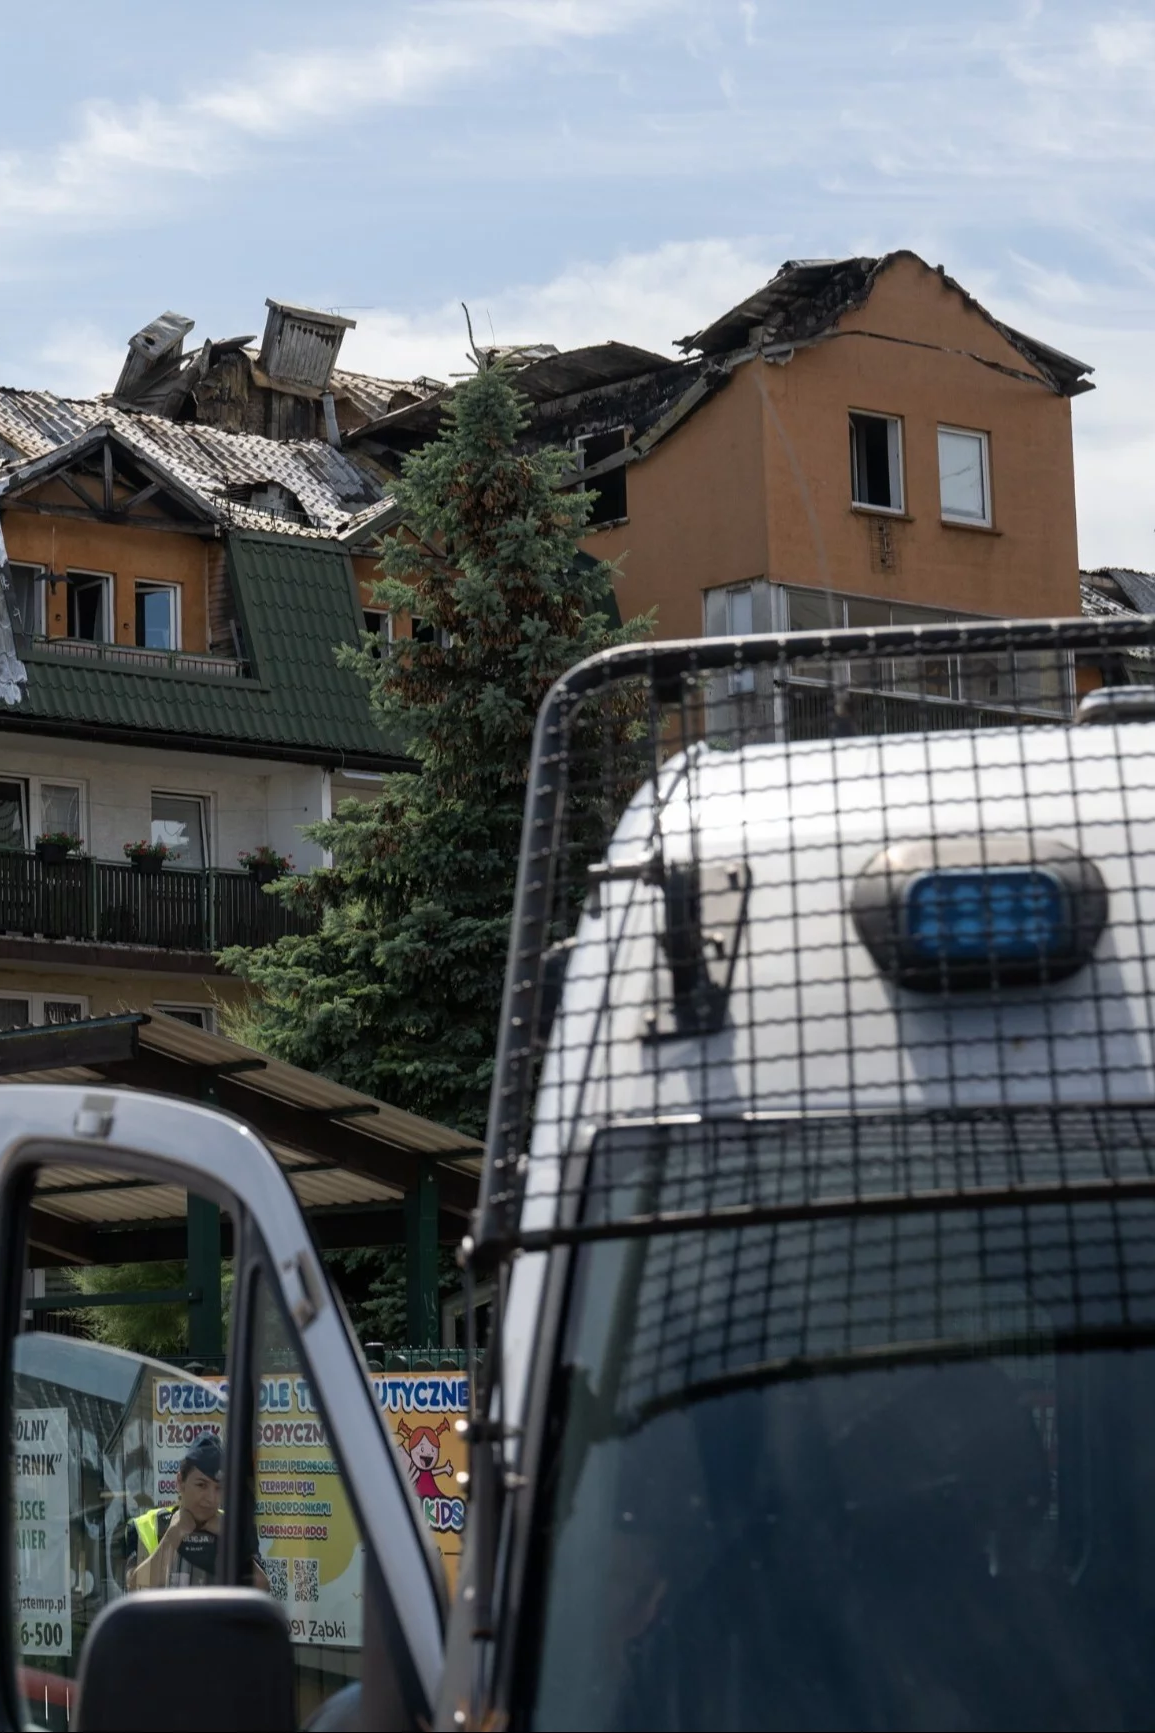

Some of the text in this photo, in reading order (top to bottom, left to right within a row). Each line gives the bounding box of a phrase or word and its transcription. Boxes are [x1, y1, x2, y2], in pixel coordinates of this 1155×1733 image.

[158, 1424, 164, 1444] I
[261, 1481, 294, 1492] TERAPIA
[274, 1502, 332, 1514] GORDONKAMI
[260, 1525, 328, 1537] DIAGNOZA ADOS
[308, 1620, 346, 1642] Ząbki
